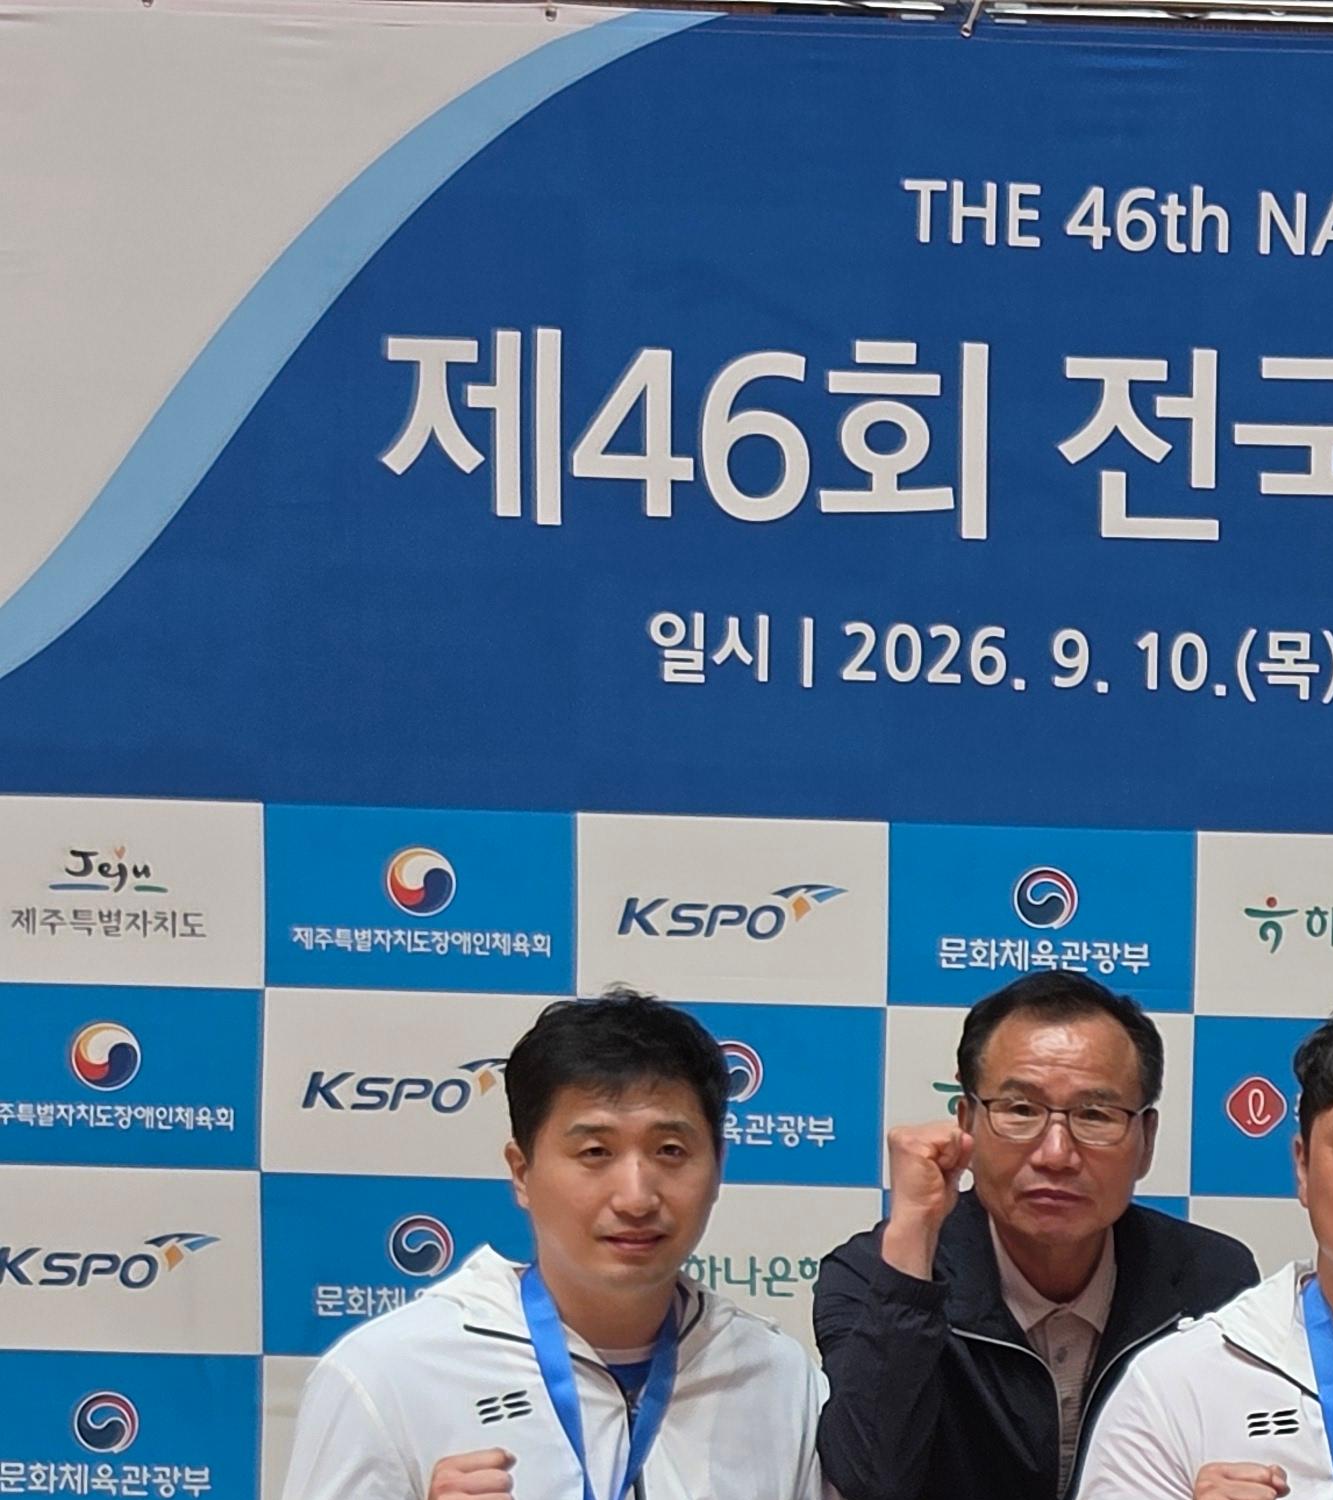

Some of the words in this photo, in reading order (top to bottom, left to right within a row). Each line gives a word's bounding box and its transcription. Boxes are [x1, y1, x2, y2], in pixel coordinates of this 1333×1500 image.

[904, 179, 1041, 248] THE
[1066, 186, 1231, 255] 46th
[380, 328, 989, 540] 제46회
[647, 611, 770, 686] 일시
[840, 621, 1028, 692] 2026.
[1052, 628, 1109, 695] 9.
[64, 846, 152, 893] Jeju
[11, 907, 207, 940] 제주특별자치도
[617, 898, 785, 941] KSPO
[292, 927, 551, 958] 제주특별자치도장애인체육회
[938, 937, 1151, 975] 문화체육관광부
[302, 1070, 471, 1114] KSPO
[0, 1247, 159, 1289] KSPO
[0, 1460, 212, 1498] 문화체육관광부
